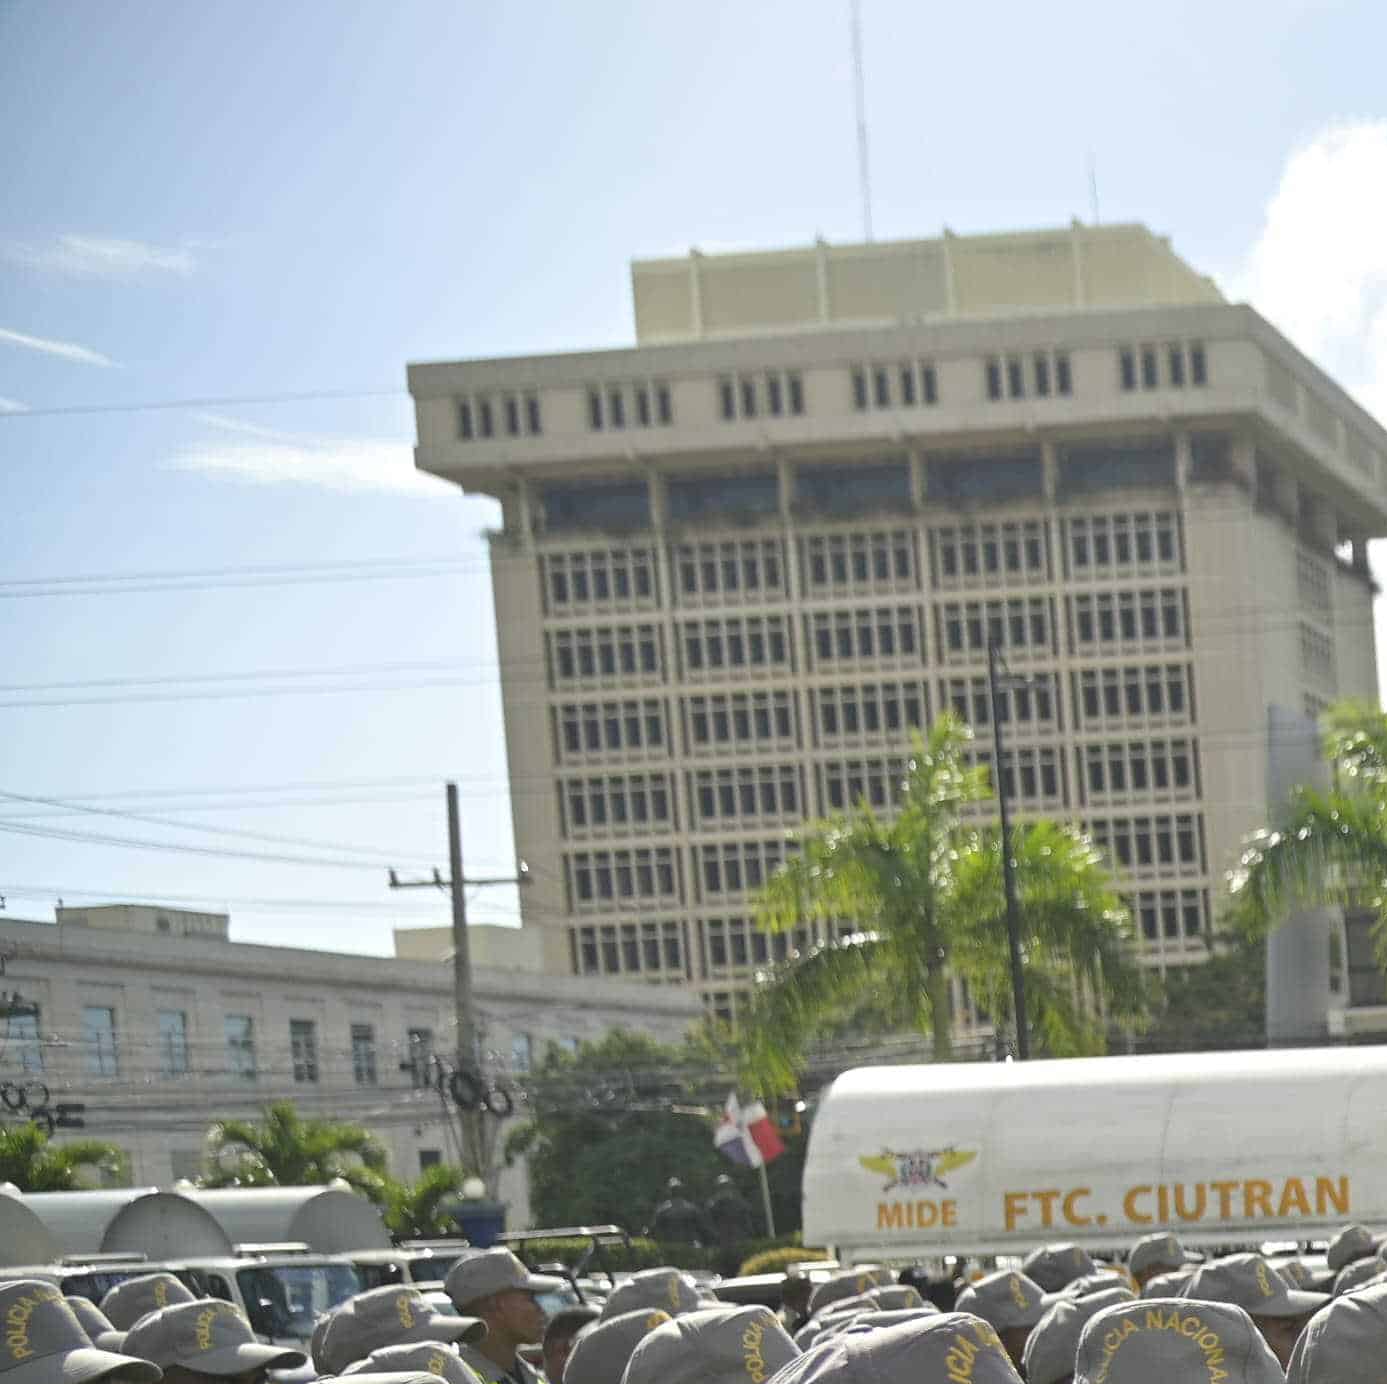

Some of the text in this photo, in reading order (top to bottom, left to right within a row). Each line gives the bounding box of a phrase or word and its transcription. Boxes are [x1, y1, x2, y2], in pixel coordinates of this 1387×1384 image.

[876, 1200, 957, 1230] MIDE
[1003, 1175, 1351, 1232] FTC. CIUTRAN
